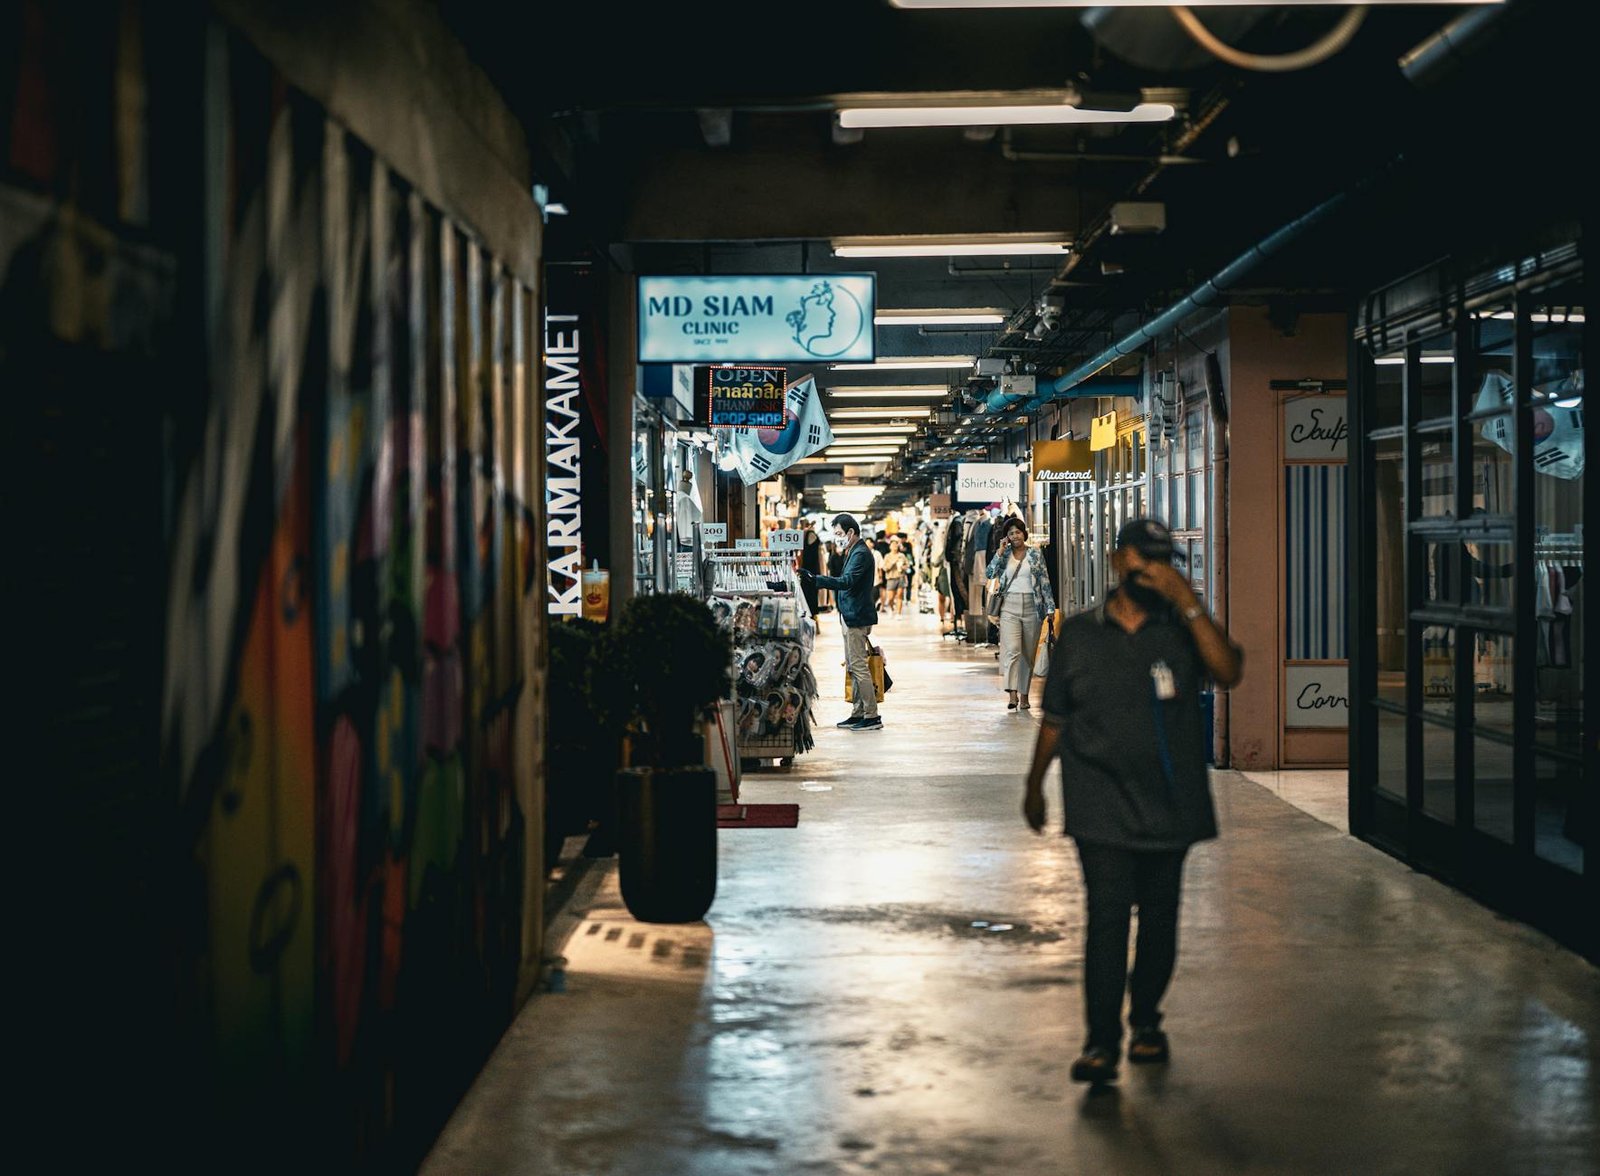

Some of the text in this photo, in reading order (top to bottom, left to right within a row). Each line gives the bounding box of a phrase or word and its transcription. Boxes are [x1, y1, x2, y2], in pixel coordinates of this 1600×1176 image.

[649, 295, 773, 316] MD SIAM
[682, 322, 739, 334] CLINIC
[716, 369, 778, 382] OPEN
[713, 412, 782, 425] KPOP SHOP
[544, 306, 583, 617] KARMAKAMET
[1036, 469, 1092, 480] Mustard
